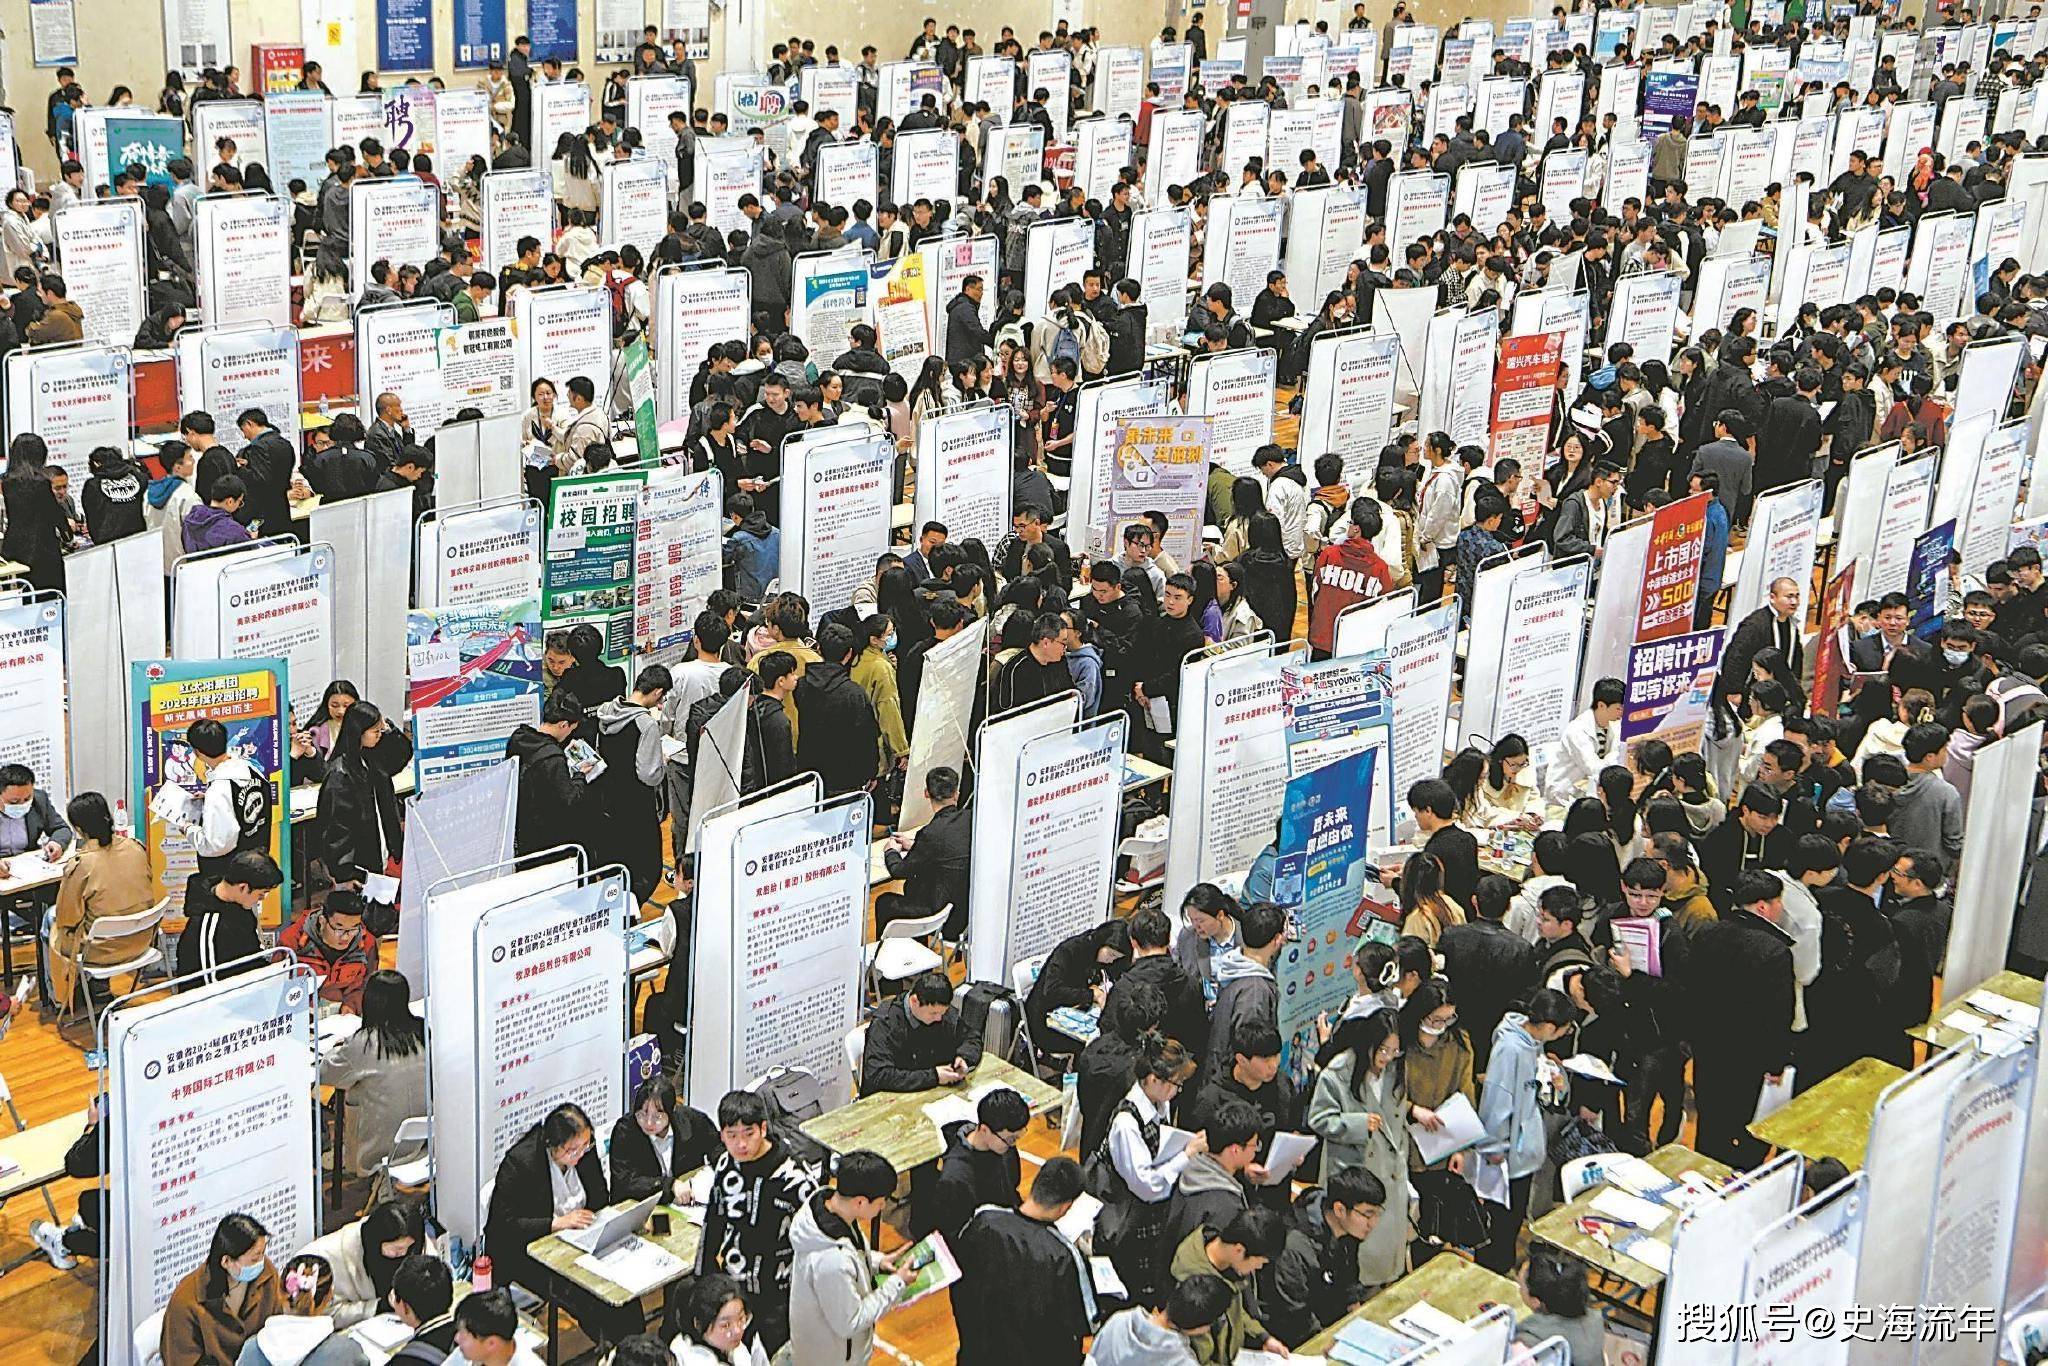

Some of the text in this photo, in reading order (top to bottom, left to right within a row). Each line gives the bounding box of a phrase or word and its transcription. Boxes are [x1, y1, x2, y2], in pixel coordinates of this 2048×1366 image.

[385, 95, 414, 149] 聘
[560, 502, 636, 529] 校园招聘
[1649, 537, 1701, 576] 上市国企
[1633, 635, 1715, 678] 招聘计划
[159, 687, 259, 710] 2024年度校园招聘
[179, 675, 239, 695] 红太阳集团
[211, 703, 254, 717] 向阳而生
[515, 946, 592, 981] 牧原食品股份有限公司
[167, 1013, 293, 1064] 安徽省2024届高校毕业生省级系列
[167, 1024, 293, 1075] 就业招聘会之理工类专场招聘会
